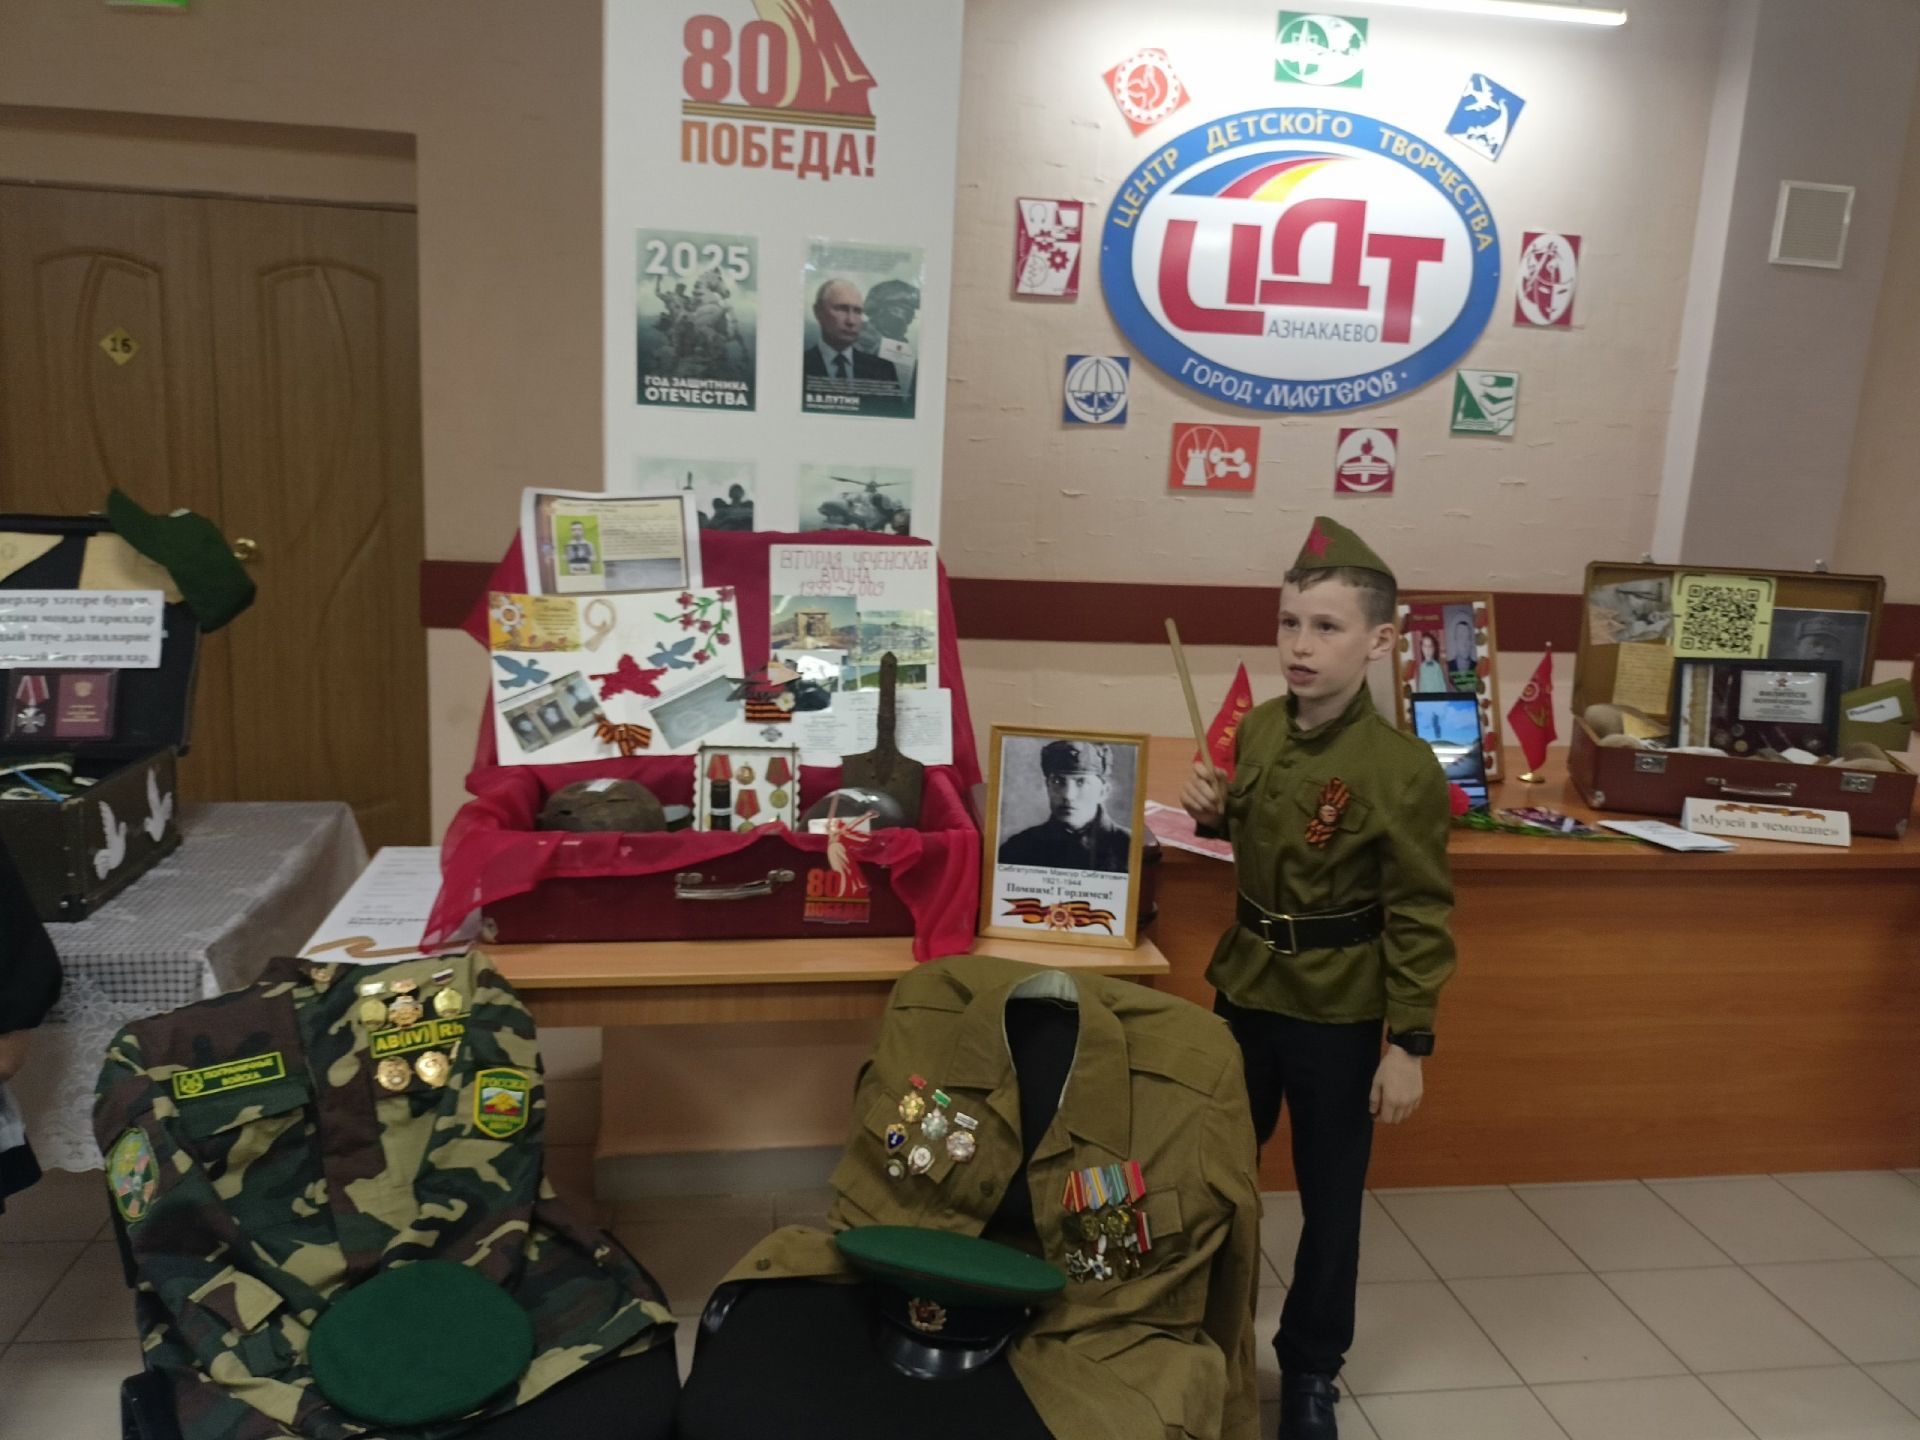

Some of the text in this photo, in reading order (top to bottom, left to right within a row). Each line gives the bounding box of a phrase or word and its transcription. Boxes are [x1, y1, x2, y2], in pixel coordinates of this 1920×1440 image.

[682, 14, 789, 107] 80
[681, 119, 876, 181] ПОБЕДА!
[1112, 111, 1494, 252] ЦЕНТР ДЕТСКОГО ТВОРЧЕСТВА
[645, 239, 750, 281] 2025
[1158, 198, 1445, 344] ЦДТ
[1267, 319, 1378, 343] АЗНАКАЕВО
[645, 375, 748, 391] ГОД ЗАЩИТНИКА
[1181, 356, 1398, 409] ГОРОД МАСТЕРОВ
[645, 387, 748, 406] ОТЕЧЕСТВА
[780, 550, 929, 570] ВТОРАЯ ЧЕЧЕНСКАЯ
[821, 567, 873, 584] ВОЙНА
[1750, 820, 1759, 829] в
[1007, 882, 1113, 900] Помним! Гордимся!
